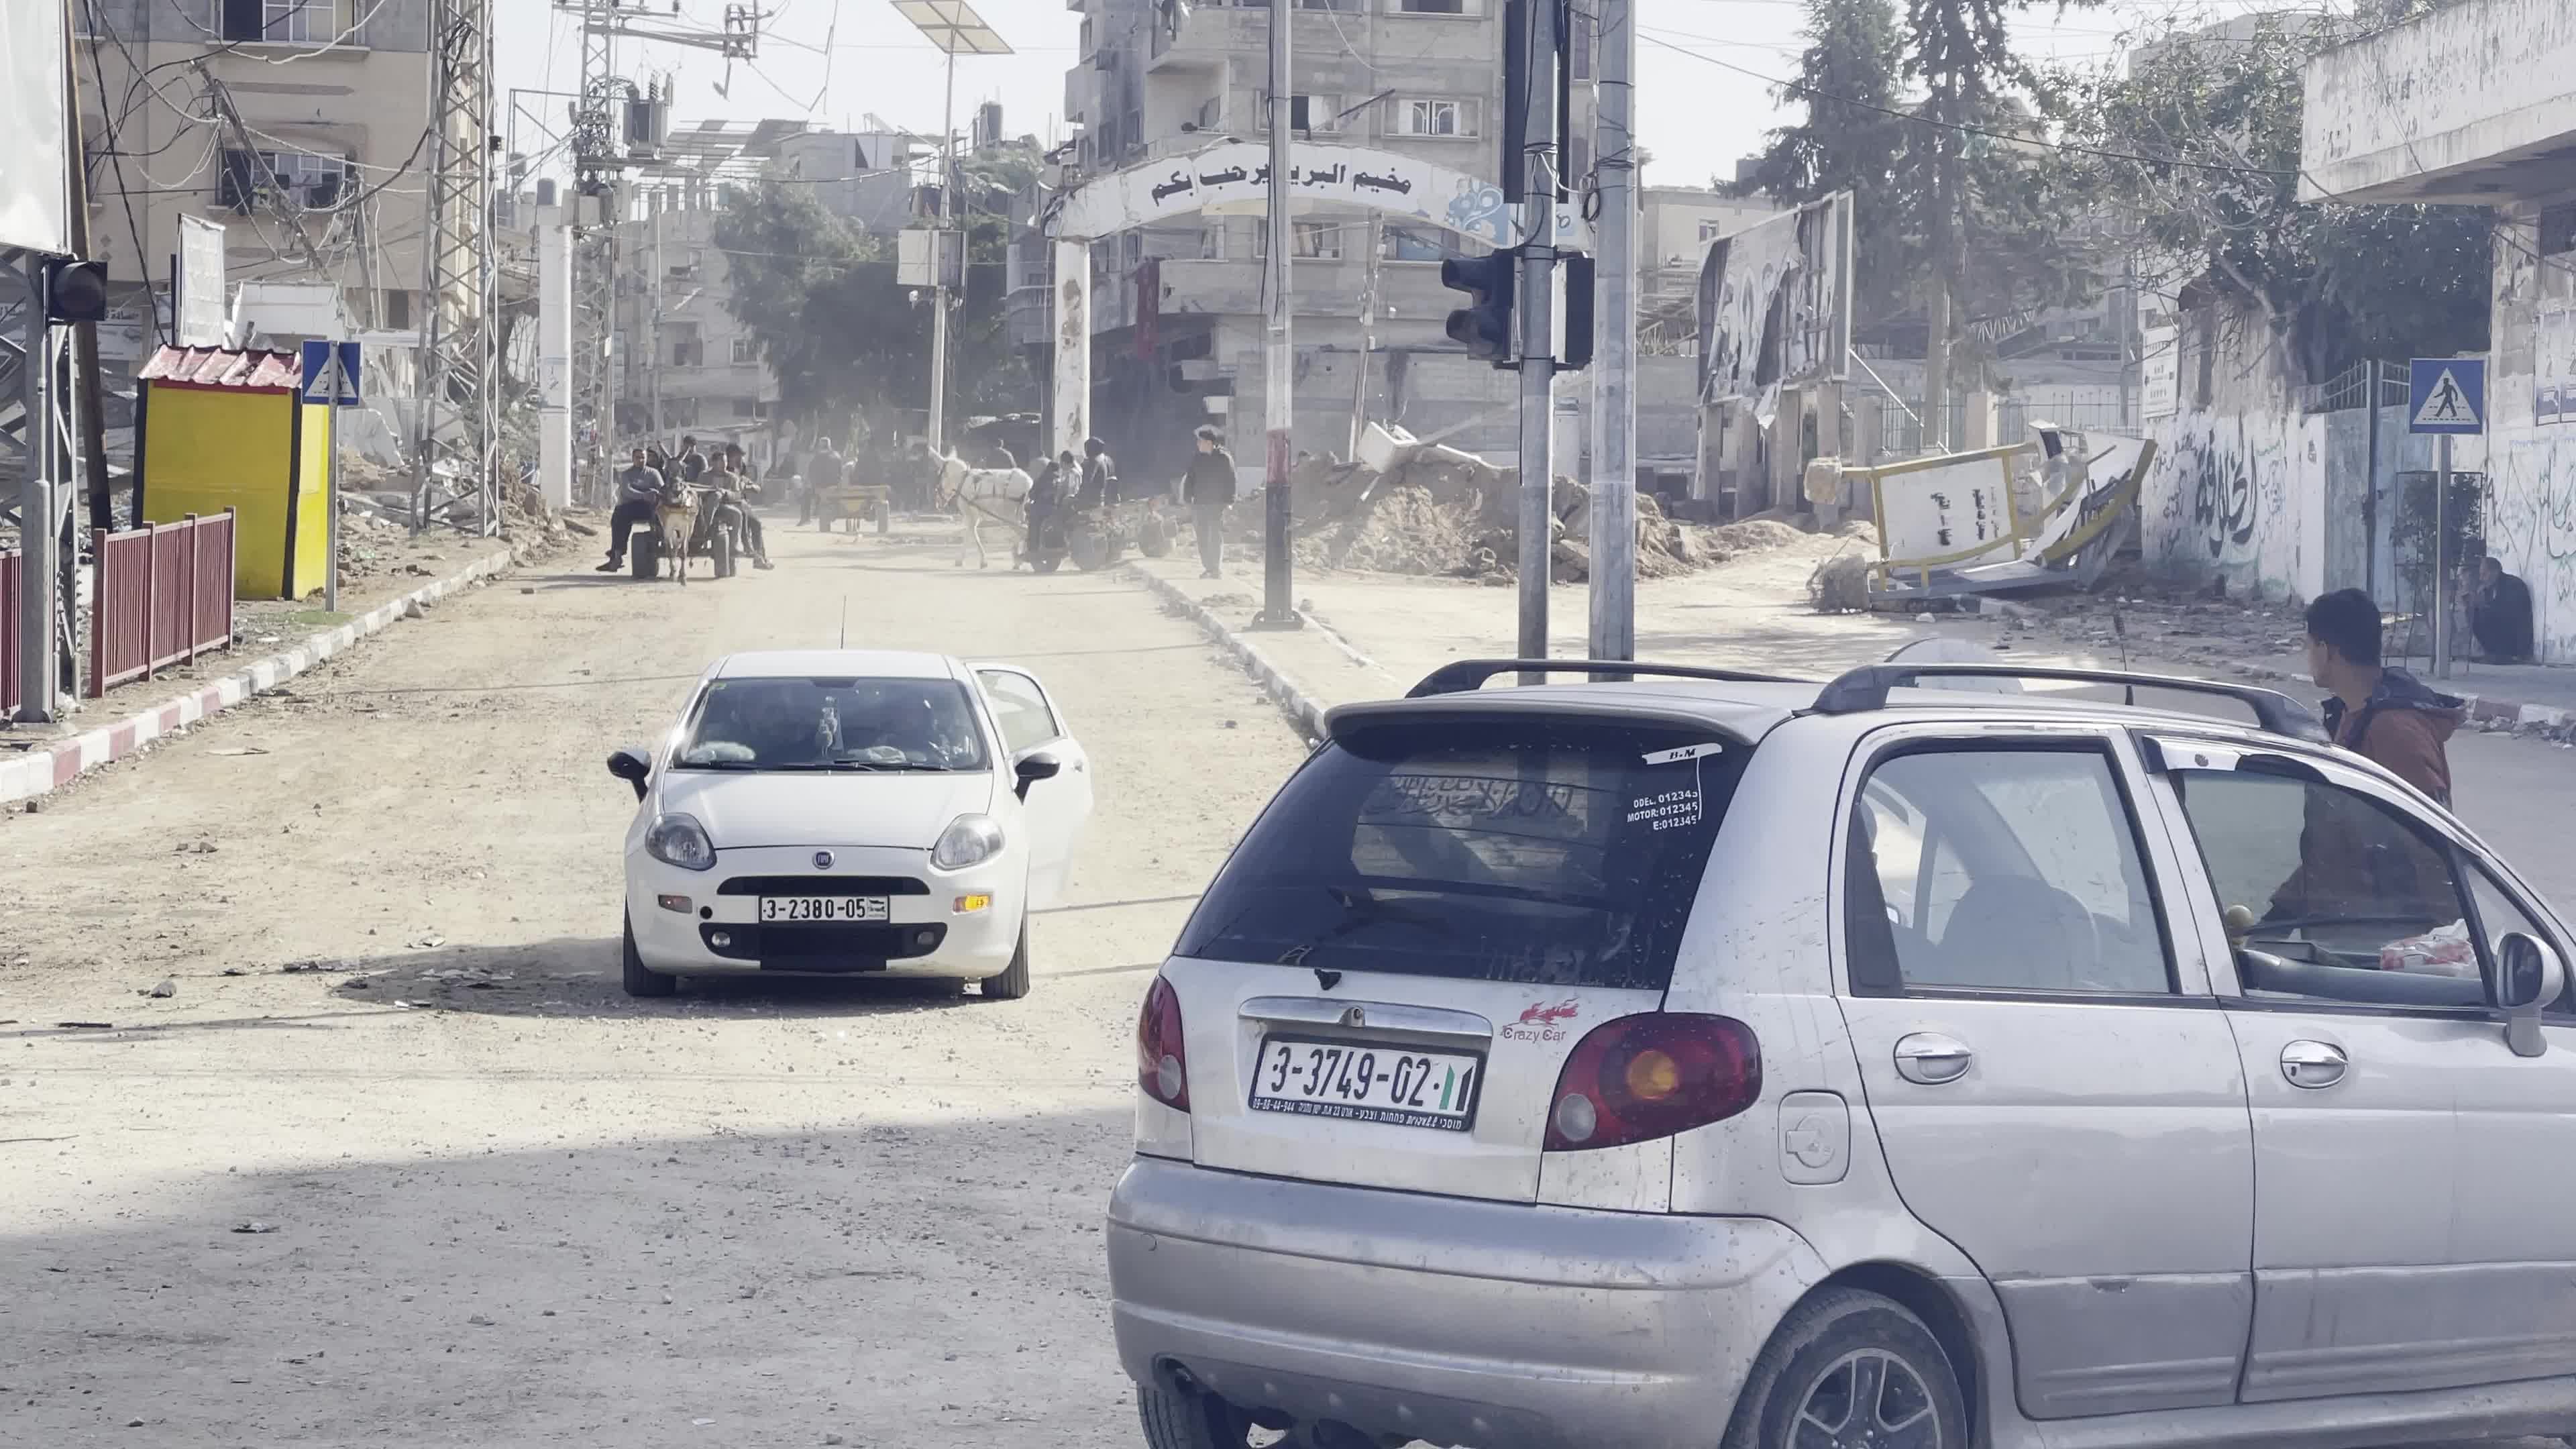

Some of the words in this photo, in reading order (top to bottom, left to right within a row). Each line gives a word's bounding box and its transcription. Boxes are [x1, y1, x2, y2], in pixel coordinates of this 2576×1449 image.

[1151, 170, 1193, 207] بكم
[1289, 163, 1346, 189] البري
[1353, 167, 1411, 195] مخيم
[767, 899, 865, 919] 3-2380-05
[1503, 1027, 1540, 1044] Crazy
[1542, 1029, 1566, 1041] Car
[1271, 1046, 1432, 1107] 3-3749-02
